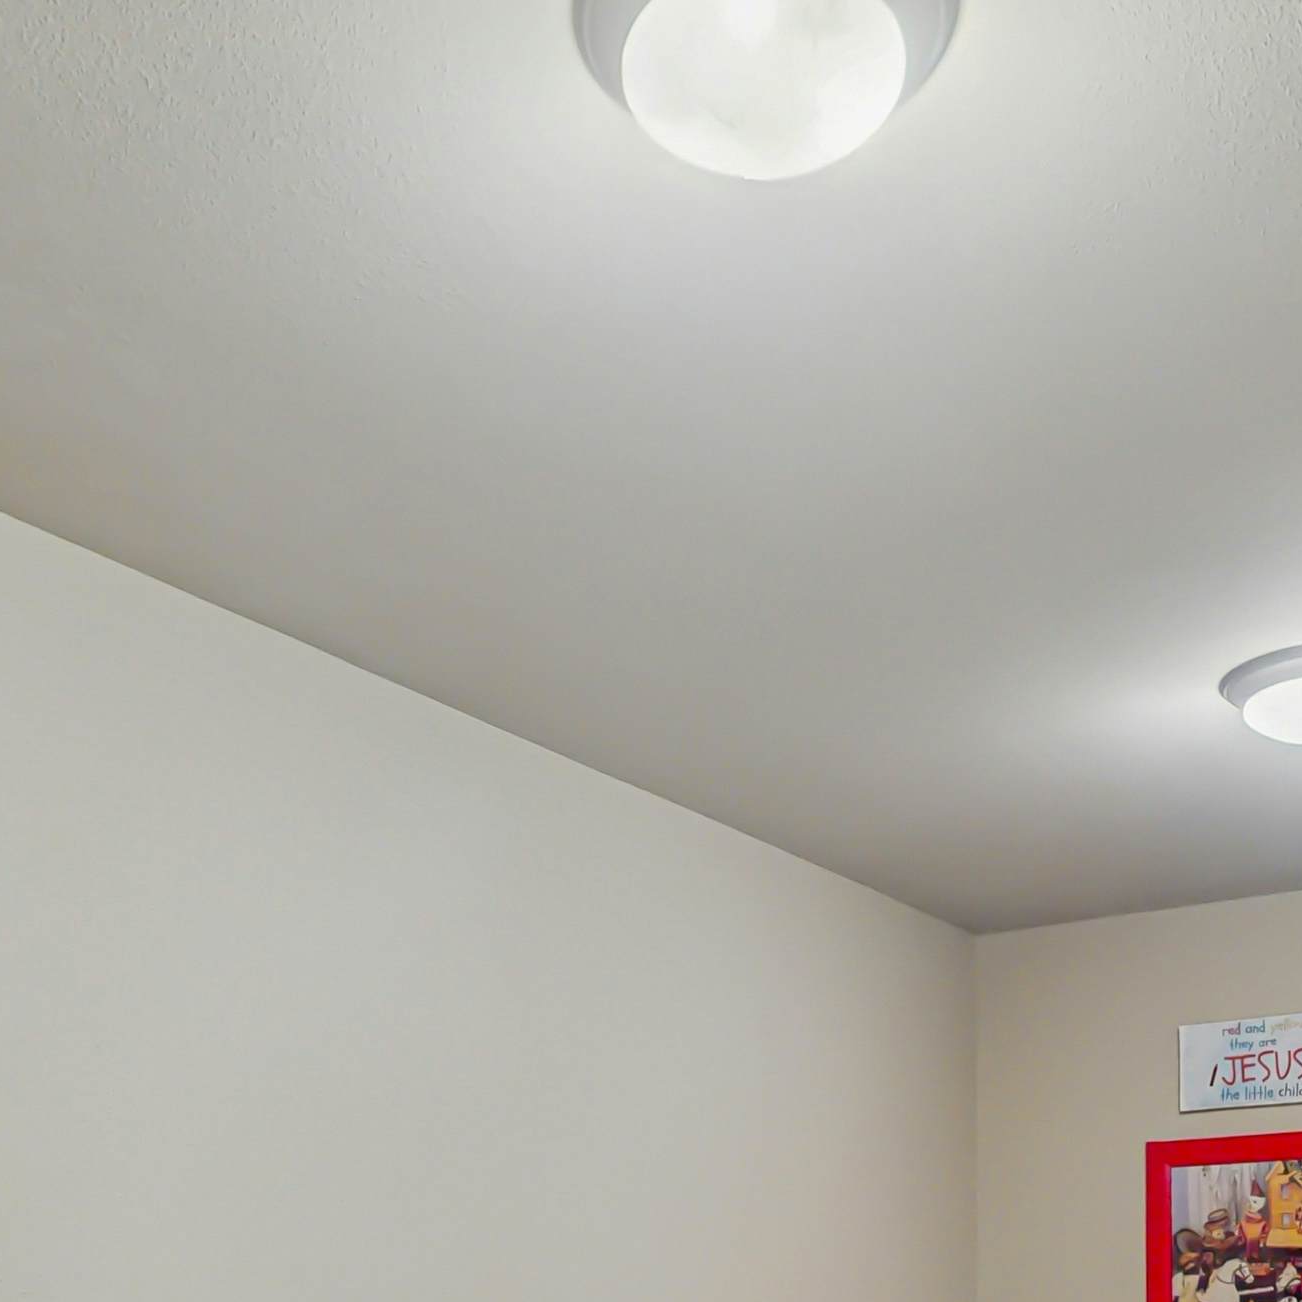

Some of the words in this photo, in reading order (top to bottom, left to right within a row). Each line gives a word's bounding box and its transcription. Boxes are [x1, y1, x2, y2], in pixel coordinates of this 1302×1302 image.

[1222, 1023, 1241, 1037] red
[1245, 1020, 1266, 1035] and
[1230, 1036, 1254, 1050] they
[1258, 1037, 1277, 1047] are
[1220, 1087, 1240, 1101] the
[1244, 1084, 1275, 1101] little
